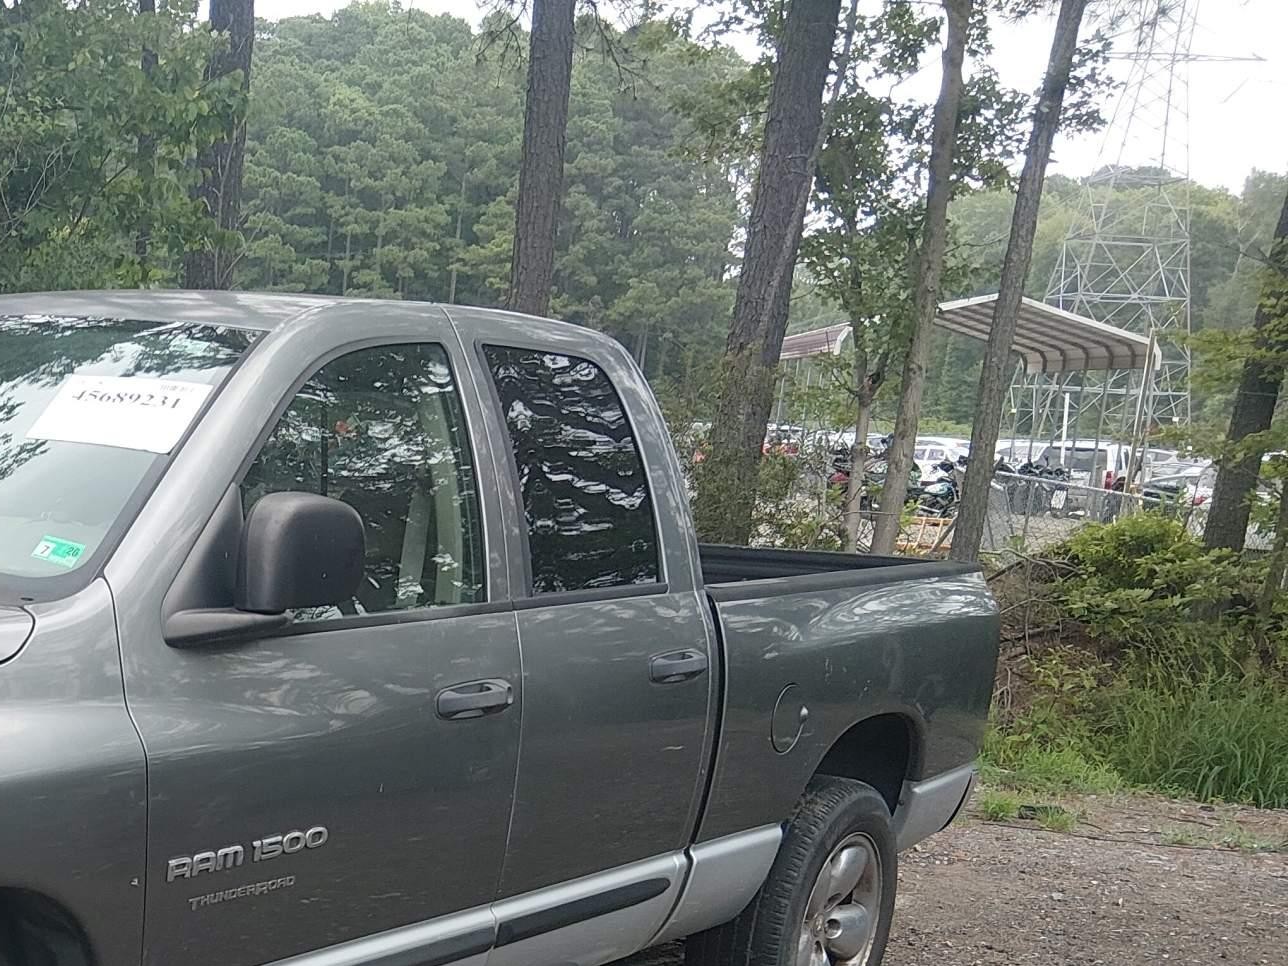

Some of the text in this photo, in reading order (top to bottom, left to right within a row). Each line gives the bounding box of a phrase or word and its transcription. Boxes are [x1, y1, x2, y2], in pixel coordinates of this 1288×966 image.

[72, 389, 181, 409] 45689231
[40, 544, 50, 555] 7
[166, 826, 328, 882] RAM 1500
